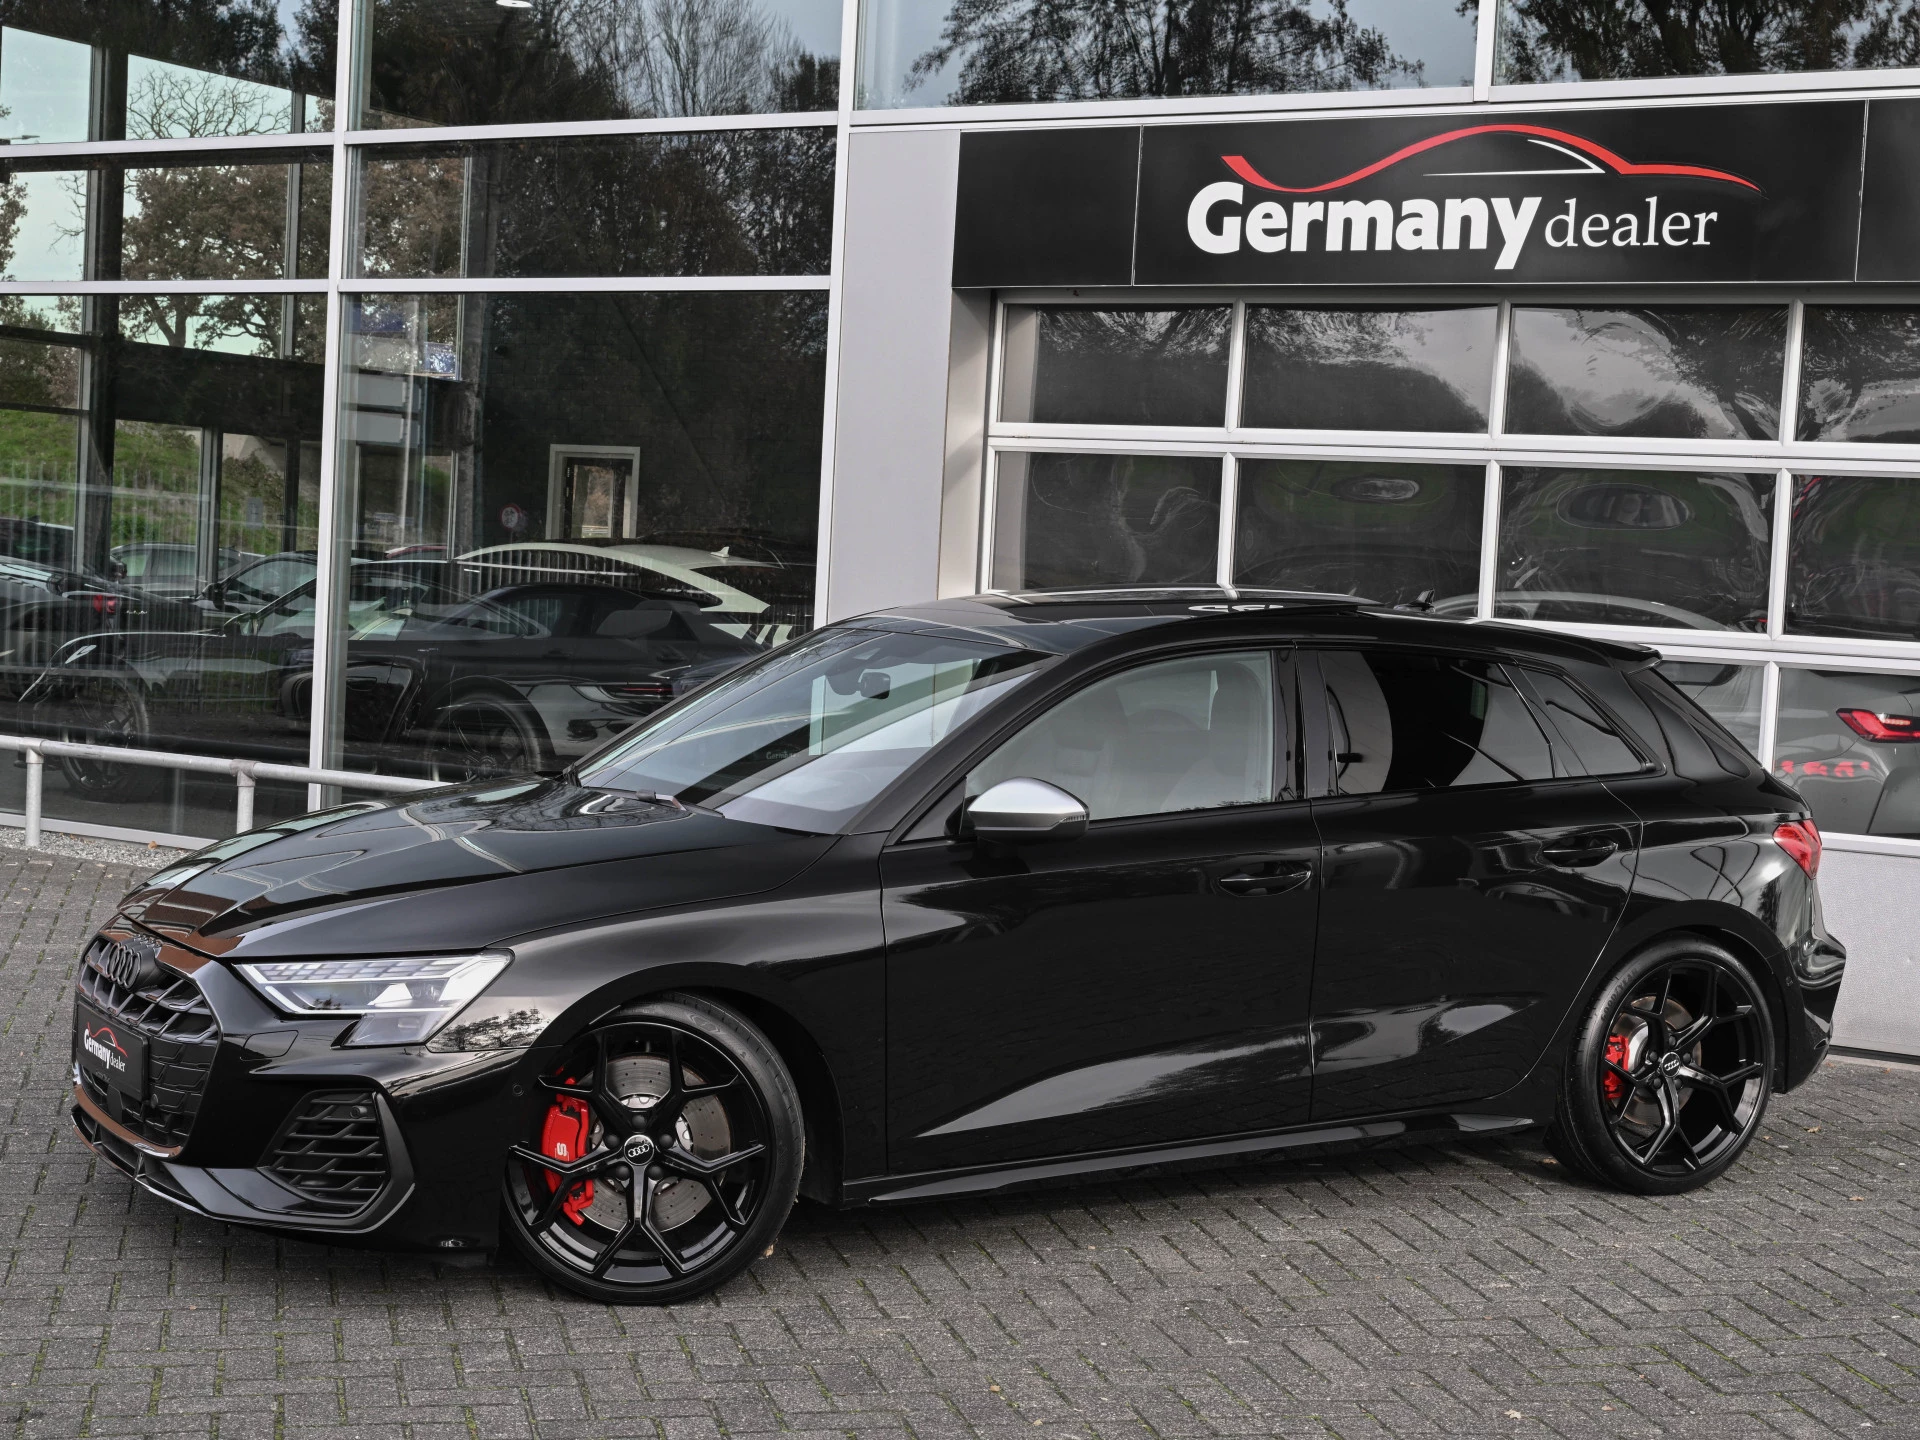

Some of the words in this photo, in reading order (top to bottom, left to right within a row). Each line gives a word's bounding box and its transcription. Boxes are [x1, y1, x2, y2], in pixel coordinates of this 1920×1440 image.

[1187, 181, 1542, 270] Germany
[1545, 196, 1718, 249] dealer
[84, 1028, 111, 1069] Germany
[110, 1052, 126, 1072] dealer
